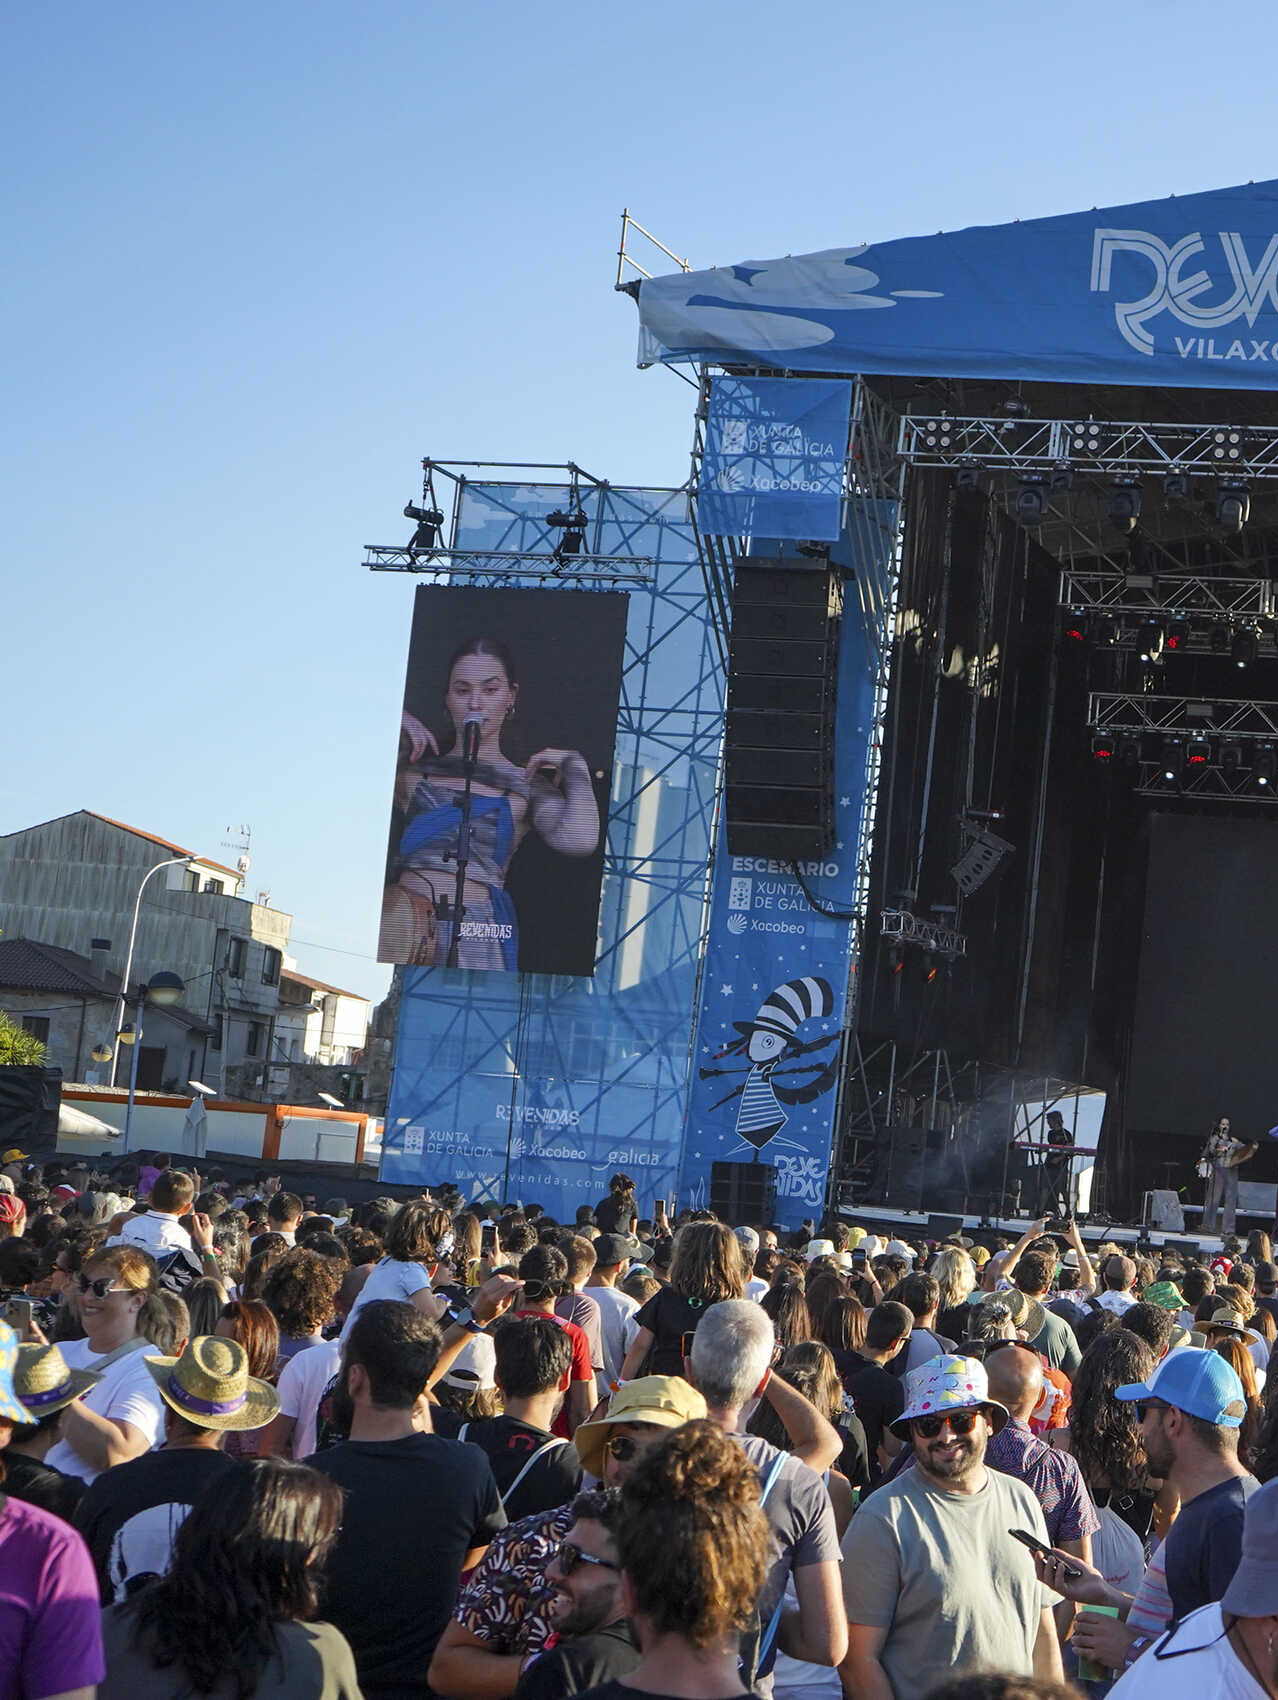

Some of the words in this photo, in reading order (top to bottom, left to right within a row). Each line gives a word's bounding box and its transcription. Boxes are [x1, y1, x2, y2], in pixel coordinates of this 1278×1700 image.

[751, 424, 802, 440] XUNTA
[748, 440, 767, 454] DE
[772, 441, 834, 456] GALICIA
[751, 475, 821, 492] Xacobeo
[732, 858, 839, 877] ESCENARIO
[756, 881, 807, 896] XUNTA
[754, 897, 773, 909] DE
[750, 919, 805, 935] Xacobeo
[495, 1104, 581, 1126] REVENIDAS
[429, 1130, 471, 1143] XUNTA
[427, 1143, 443, 1154] DE
[446, 1144, 494, 1158] GALICIA
[528, 1144, 586, 1160] Xacobeo
[592, 1148, 660, 1171] galicia
[455, 1169, 606, 1190] www.revenidas.com
